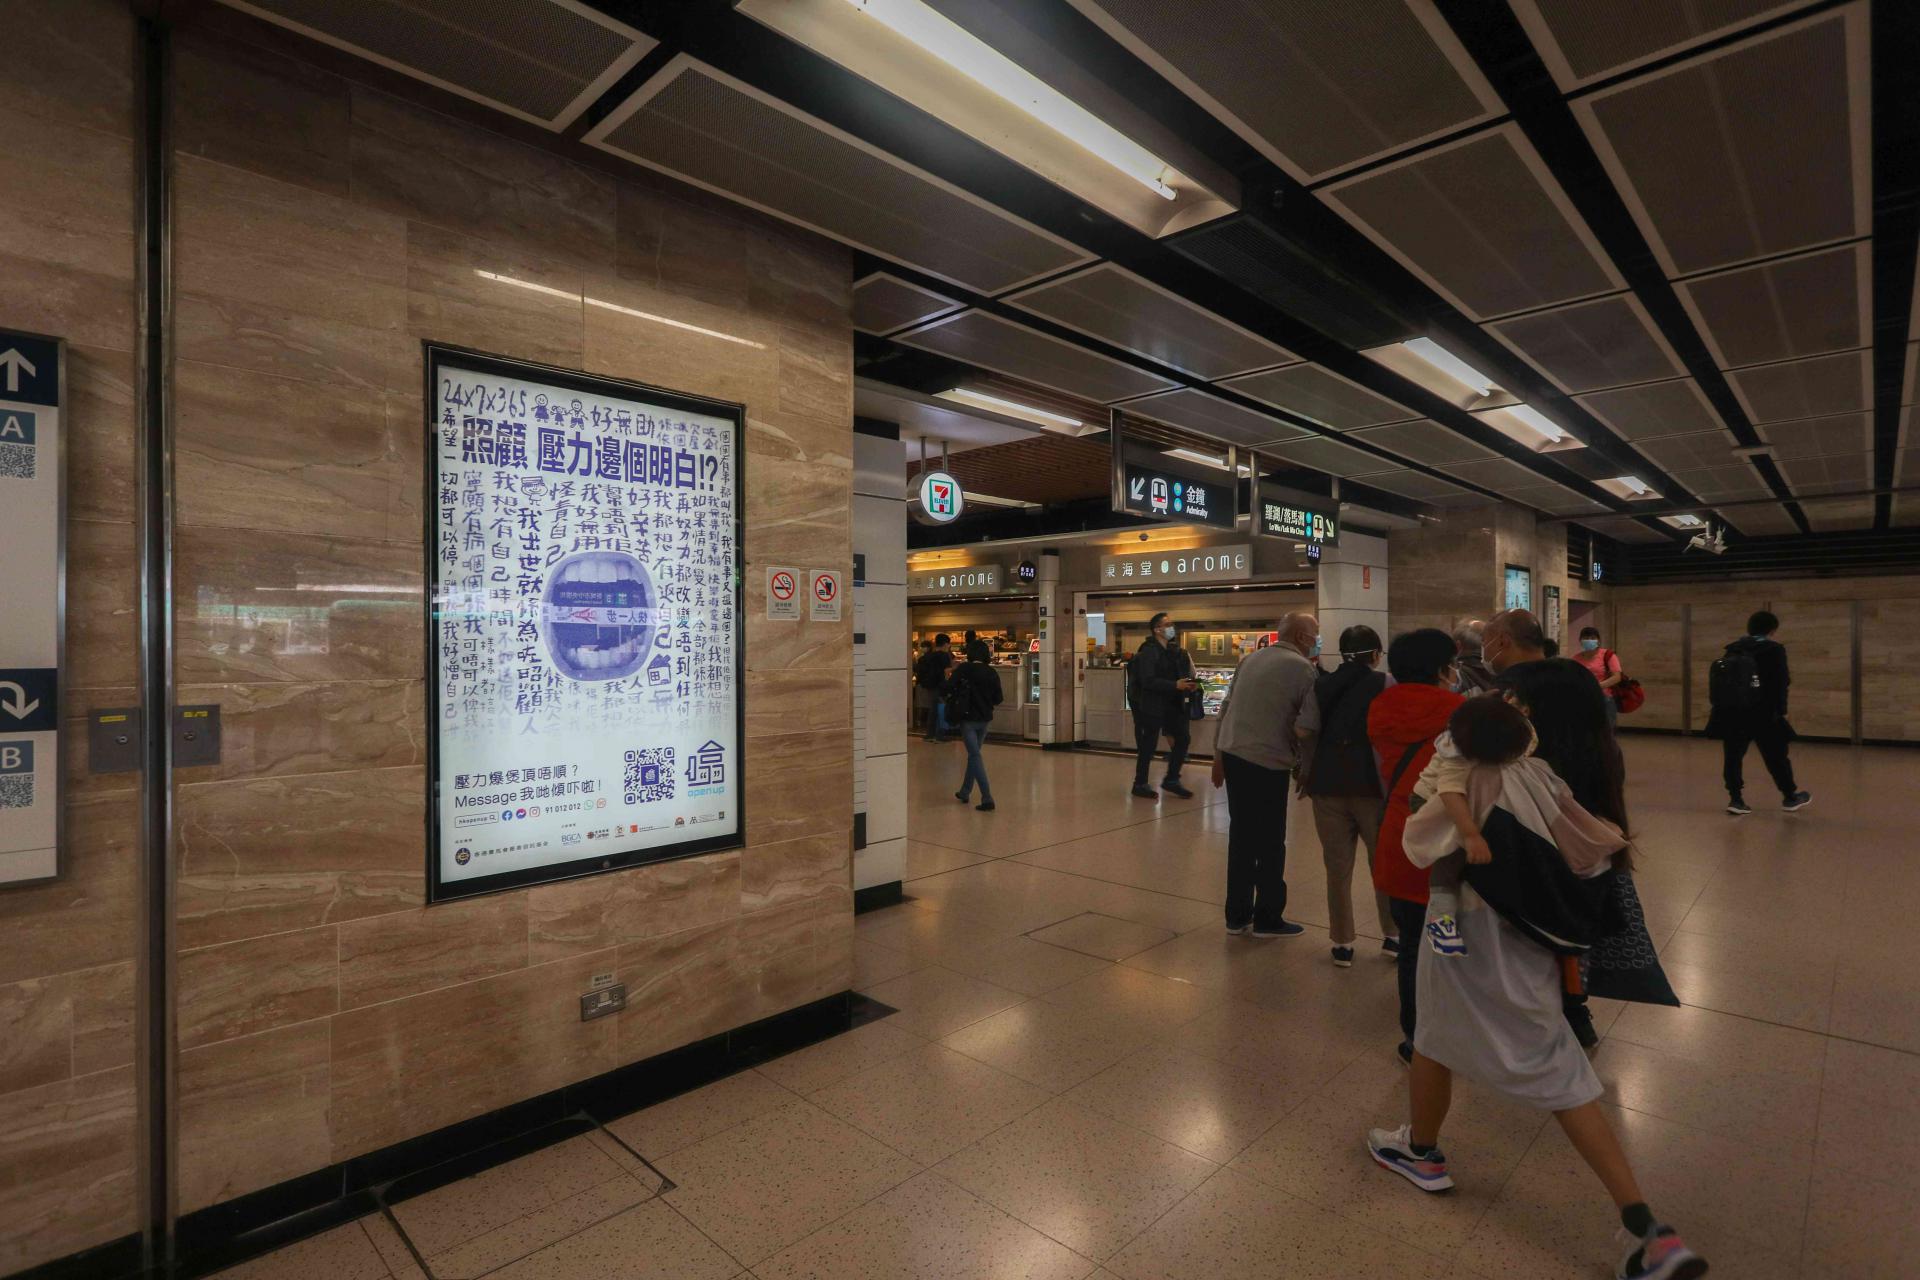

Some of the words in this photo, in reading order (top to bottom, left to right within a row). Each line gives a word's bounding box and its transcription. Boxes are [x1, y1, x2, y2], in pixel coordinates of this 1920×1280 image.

[0, 415, 25, 438] A
[590, 405, 655, 438] 好無助
[462, 414, 529, 470] 照顧
[934, 485, 949, 513] 7
[1186, 485, 1205, 506] 金鐘
[1186, 505, 1209, 519] Admiralty
[626, 487, 652, 564] 好辛苦
[1105, 560, 1152, 577] 東海堂
[1177, 554, 1245, 573] arome
[950, 573, 993, 587] arome
[2, 747, 21, 769] B
[455, 792, 517, 808] Message
[545, 806, 553, 814] 91
[555, 804, 567, 813] 012
[569, 803, 581, 811] 012
